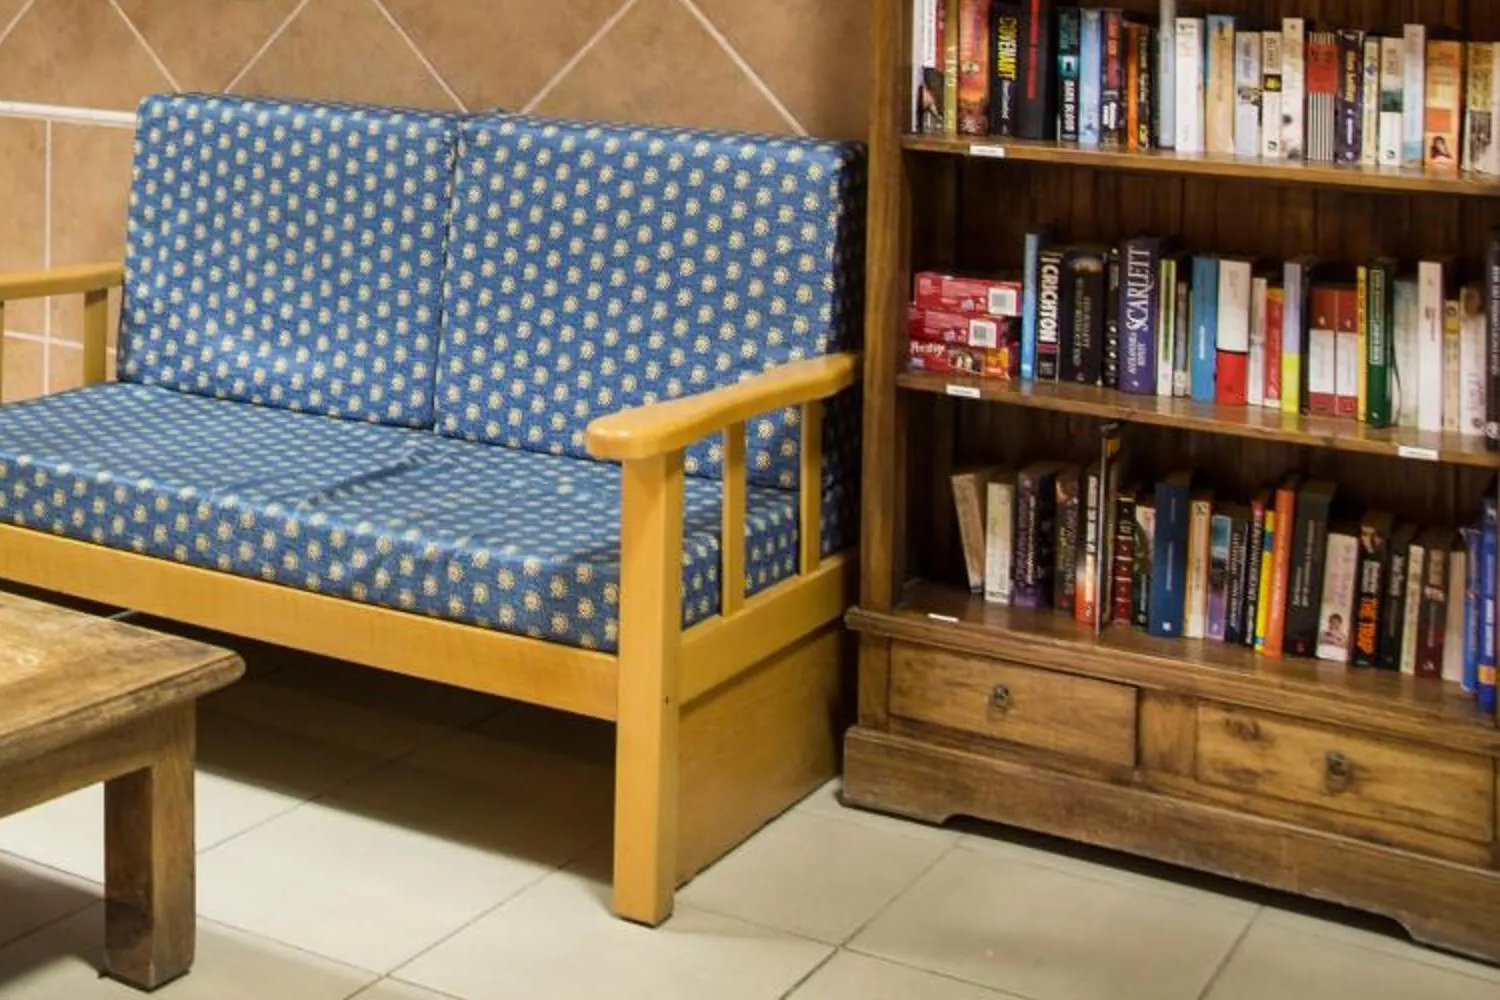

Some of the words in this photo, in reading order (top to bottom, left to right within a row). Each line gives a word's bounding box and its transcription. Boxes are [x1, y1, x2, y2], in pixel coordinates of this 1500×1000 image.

[998, 17, 1018, 80] COVENANT
[1039, 263, 1060, 342] CRICHTON
[1125, 246, 1154, 331] SCARLETT
